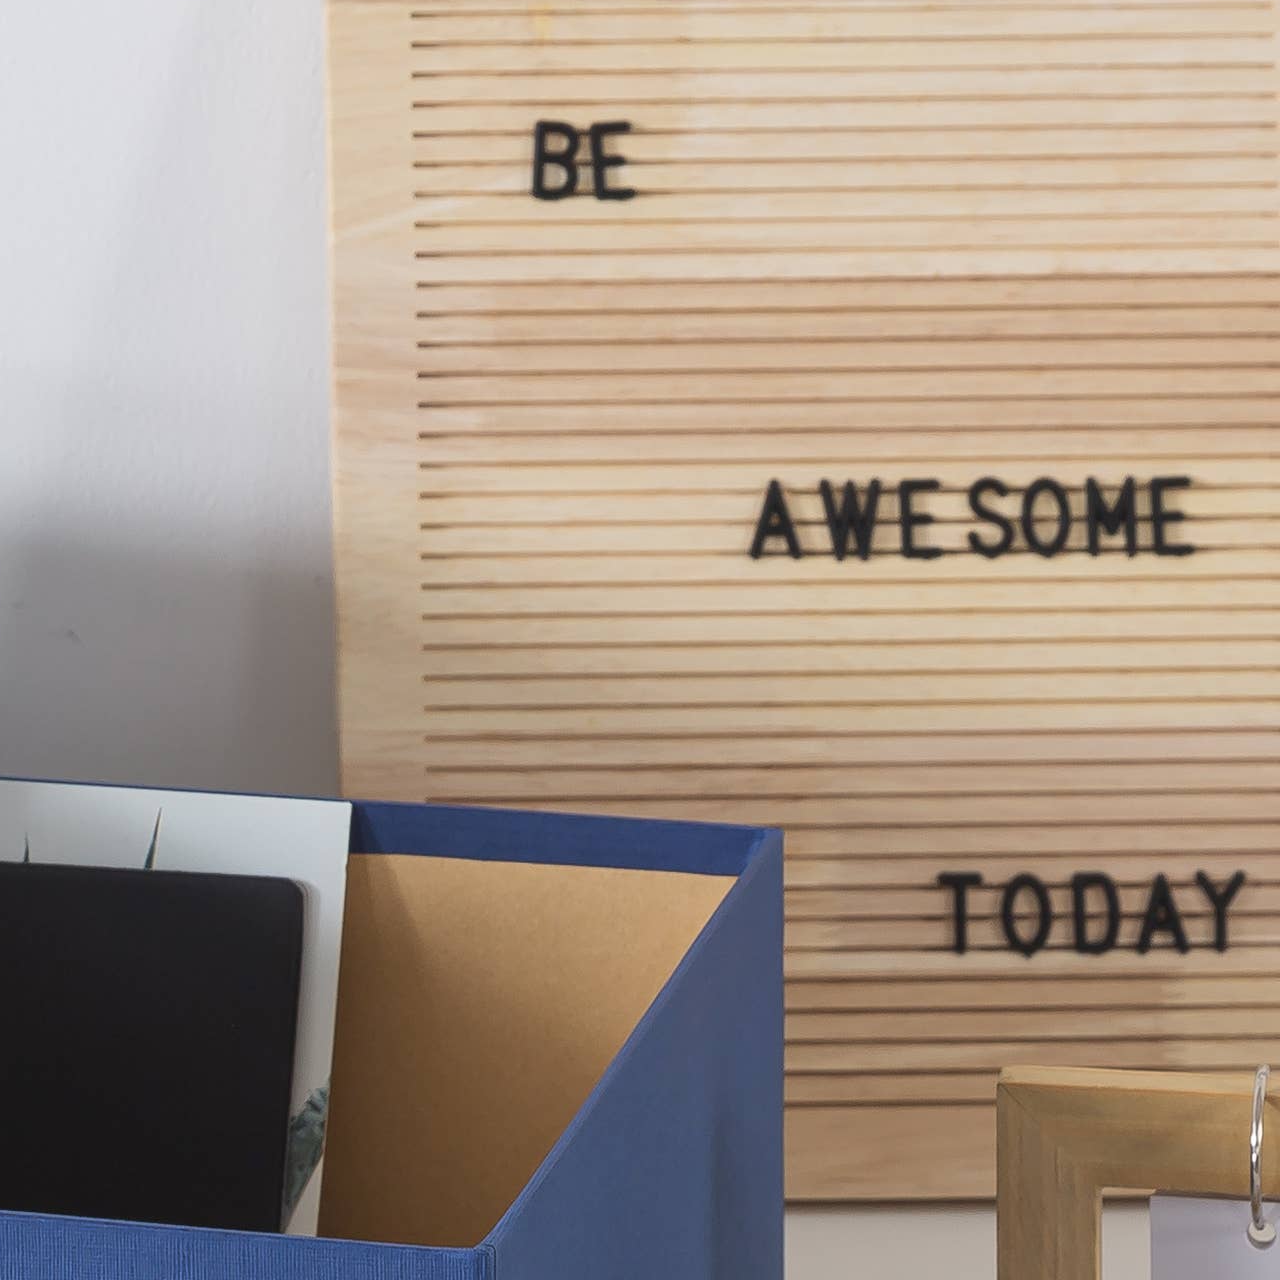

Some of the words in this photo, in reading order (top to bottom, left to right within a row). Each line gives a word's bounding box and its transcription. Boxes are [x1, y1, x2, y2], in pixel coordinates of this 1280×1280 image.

[528, 120, 636, 201] BE
[747, 476, 1197, 561] AWESOME
[937, 871, 1246, 958] TODAY
